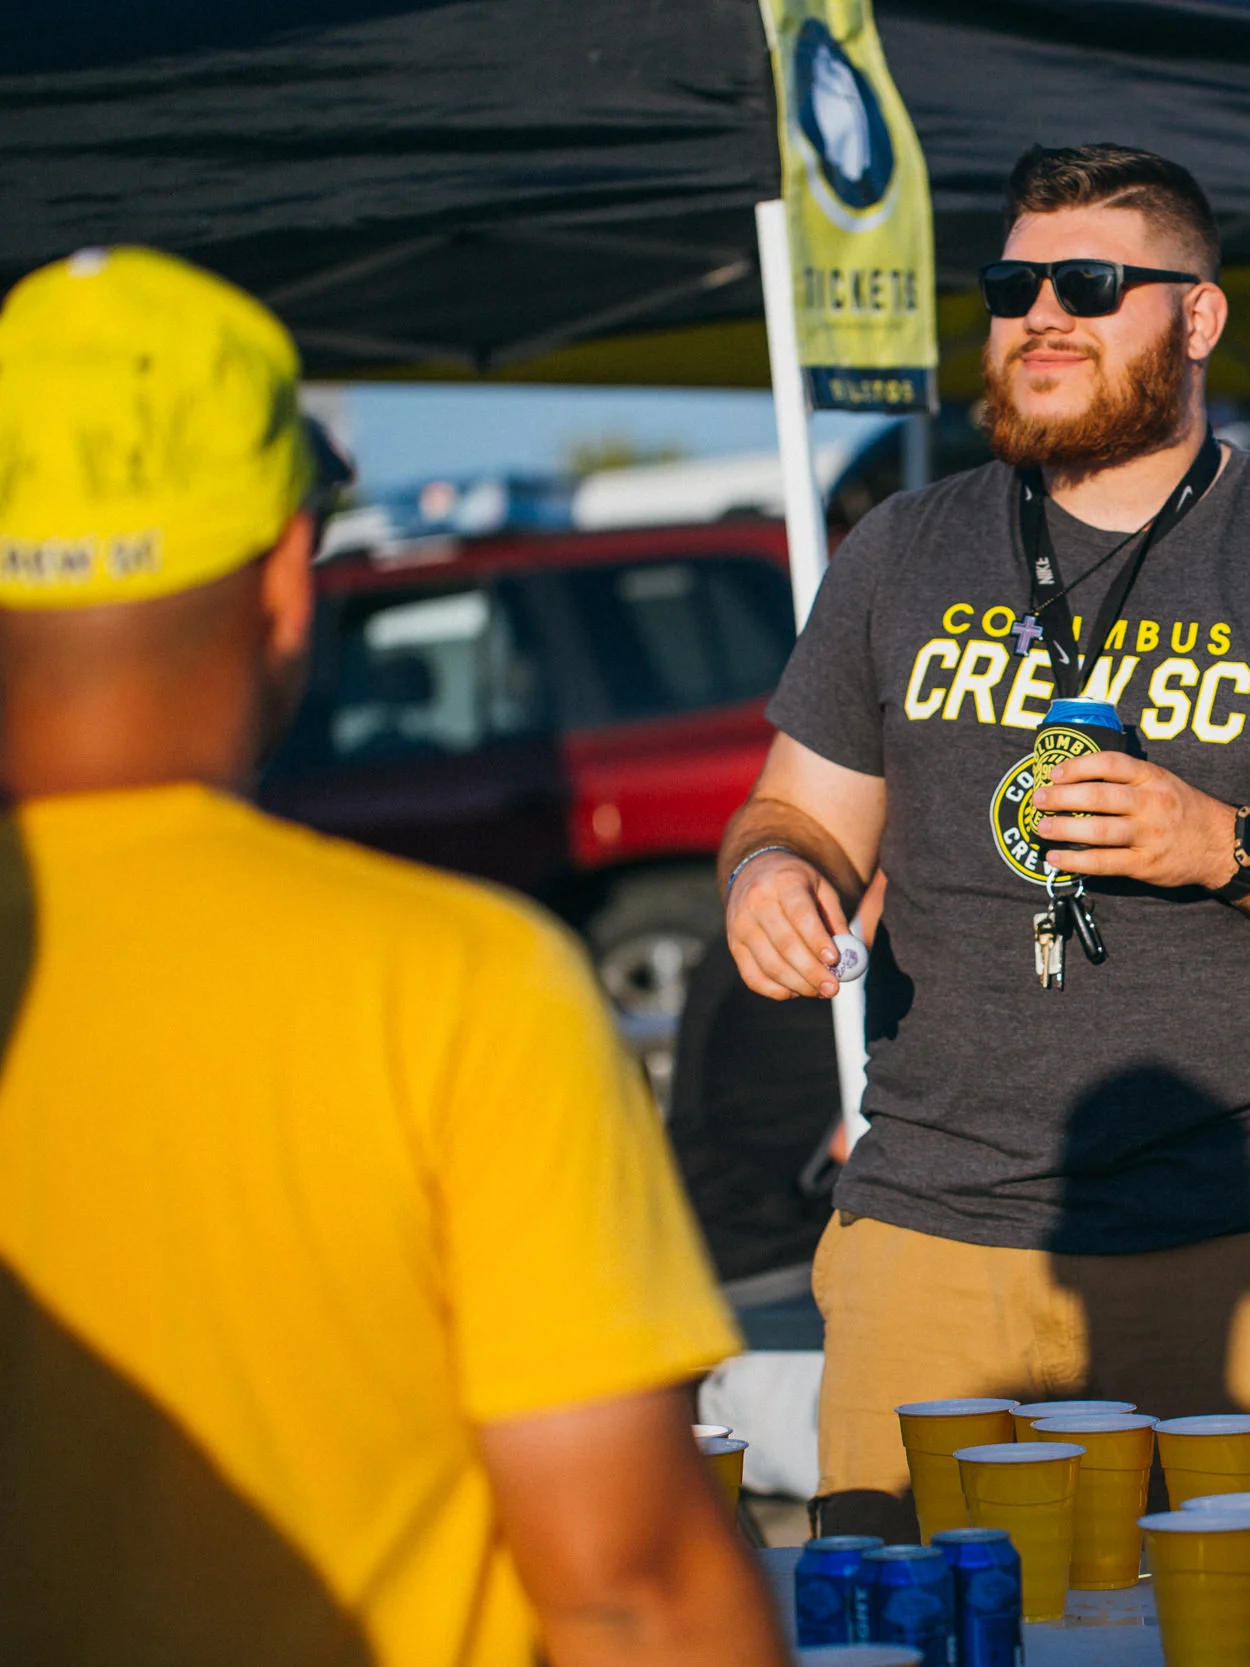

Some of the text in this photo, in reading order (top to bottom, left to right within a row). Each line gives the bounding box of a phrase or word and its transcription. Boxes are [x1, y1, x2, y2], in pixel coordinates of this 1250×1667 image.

[803, 268, 917, 312] TICKETS
[1035, 556, 1055, 585] NIKE
[942, 602, 1232, 656] COMBUS
